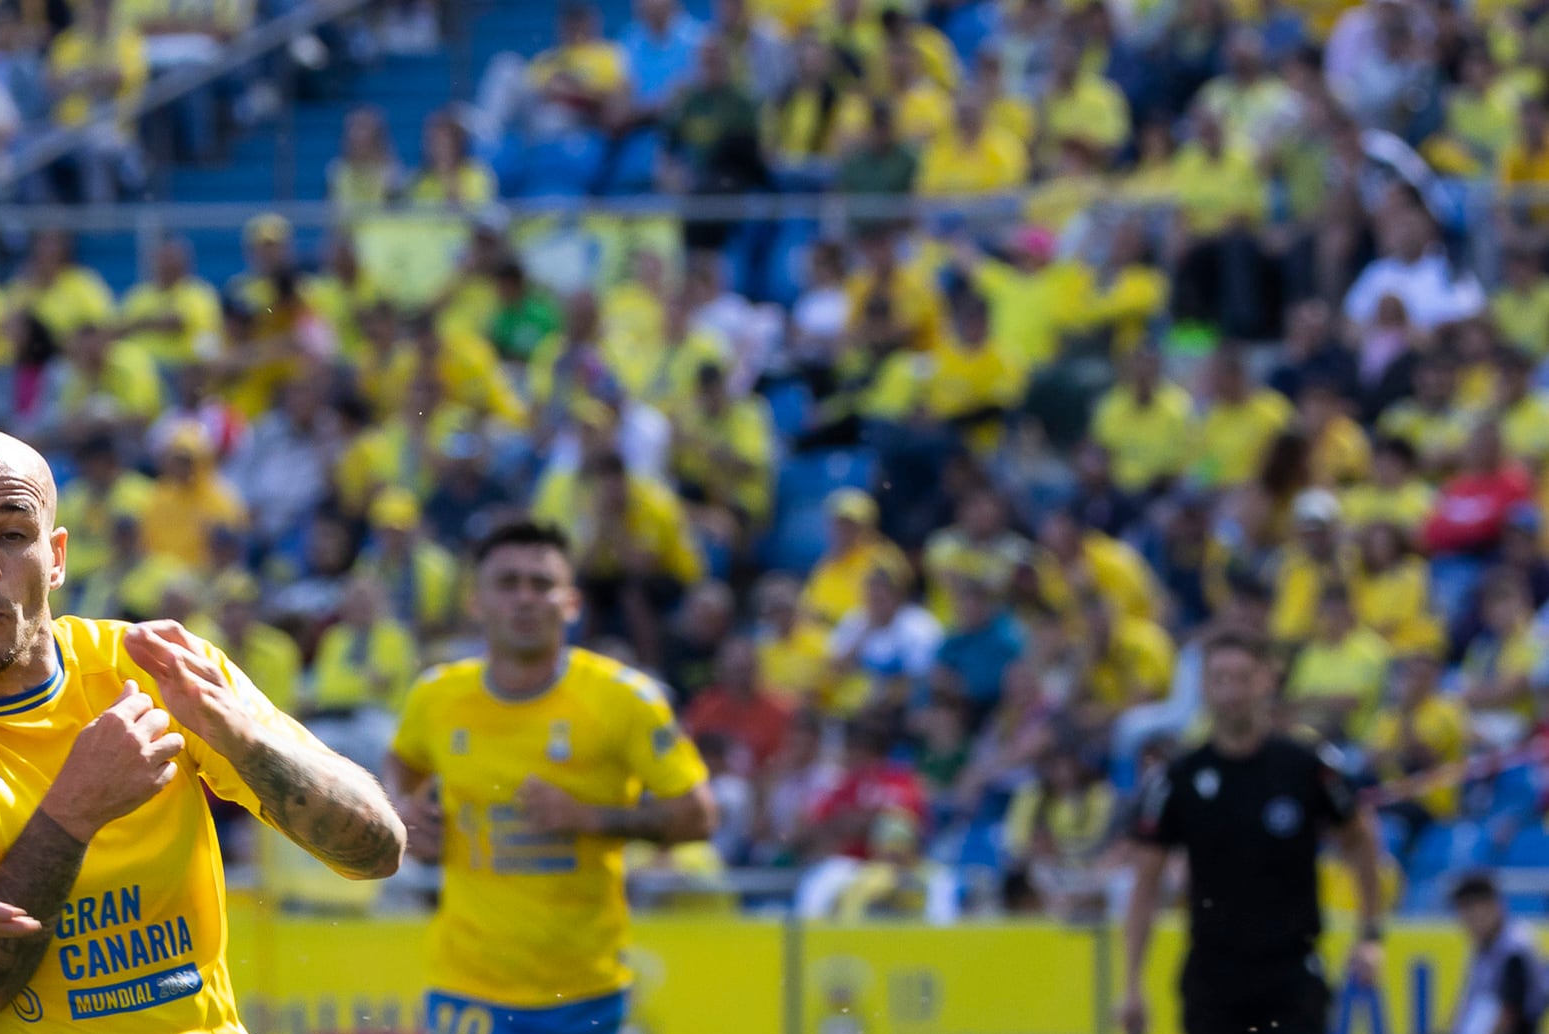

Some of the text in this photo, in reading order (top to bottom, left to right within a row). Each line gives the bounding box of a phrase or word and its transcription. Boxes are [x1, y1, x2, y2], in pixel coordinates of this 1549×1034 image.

[55, 884, 141, 940] GRAN
[59, 915, 193, 981] CANARIA
[74, 981, 156, 1015] MUNDIAL
